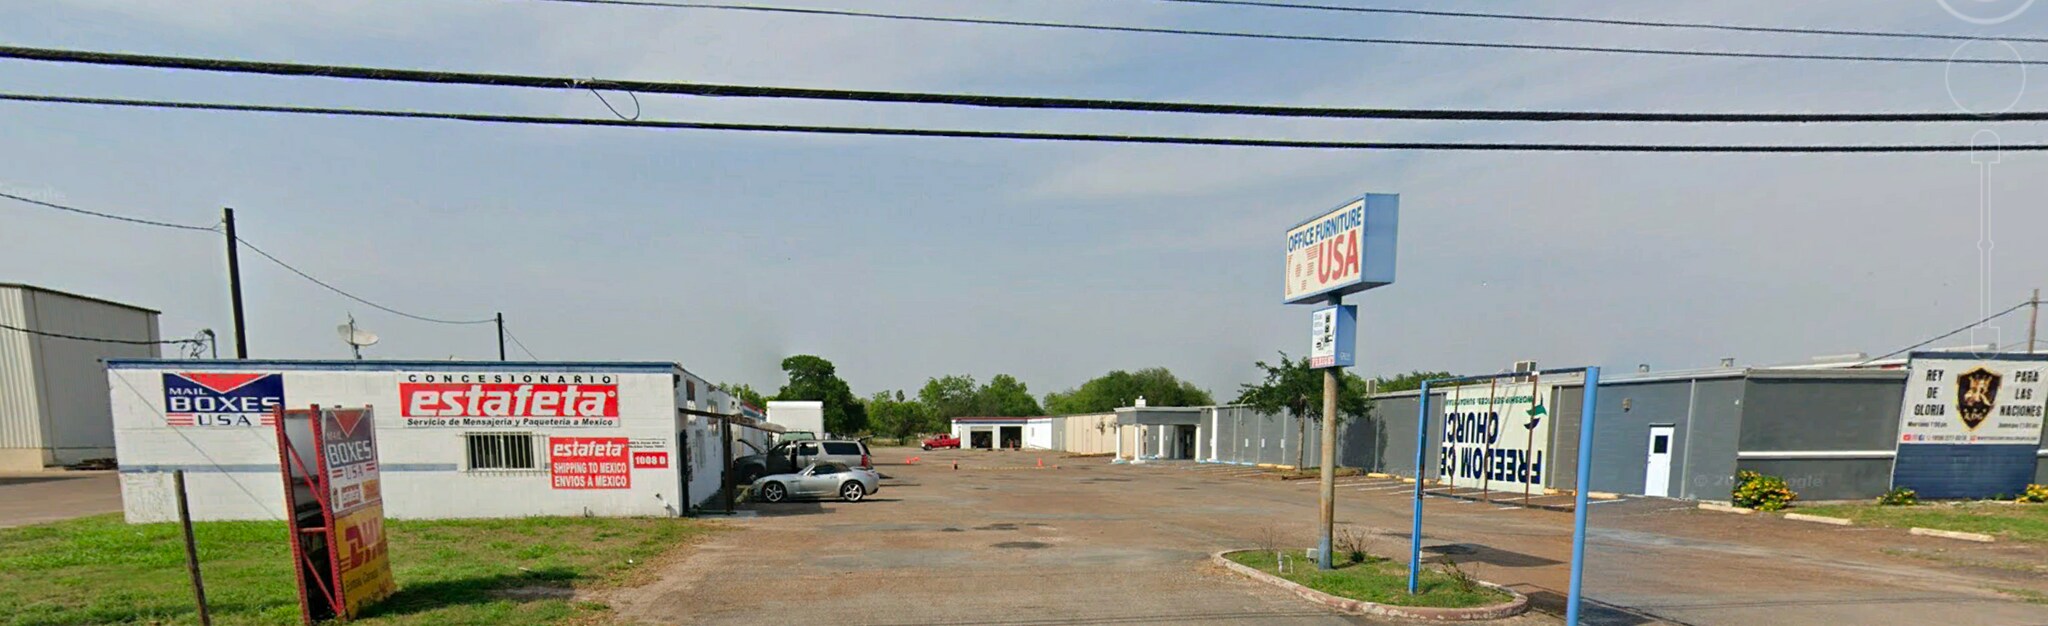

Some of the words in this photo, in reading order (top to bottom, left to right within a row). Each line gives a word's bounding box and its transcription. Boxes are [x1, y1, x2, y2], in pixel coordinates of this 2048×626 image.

[1288, 226, 1315, 253] OFFICE
[1315, 206, 1362, 243] FURNITURE
[1318, 229, 1359, 285] USA
[408, 374, 611, 384] CONCESIONARIO
[1926, 369, 1944, 382] REY
[2014, 371, 2039, 383] PARA
[169, 387, 208, 396] MAIL
[1927, 387, 1938, 399] DE
[2014, 388, 2034, 400] LAS
[170, 397, 281, 412] BOXES
[409, 385, 607, 416] estafeta
[1914, 404, 1945, 416] GLORIA
[1999, 405, 2042, 417] NACIONES
[198, 415, 251, 426] USA
[407, 418, 445, 426] Servicio
[449, 418, 459, 426] de
[515, 419, 521, 428] y
[582, 418, 613, 426] Mexico
[328, 440, 372, 465] BOXES
[553, 441, 622, 457] estafeta
[554, 462, 586, 473] SHIPPING
[588, 462, 598, 473] TO
[600, 462, 627, 473] MEXICO
[1460, 447, 1542, 484] FREEDOM
[345, 464, 364, 480] USA
[554, 475, 586, 487] ENVIOS
[587, 475, 594, 487] A
[595, 475, 627, 487] MEXICO
